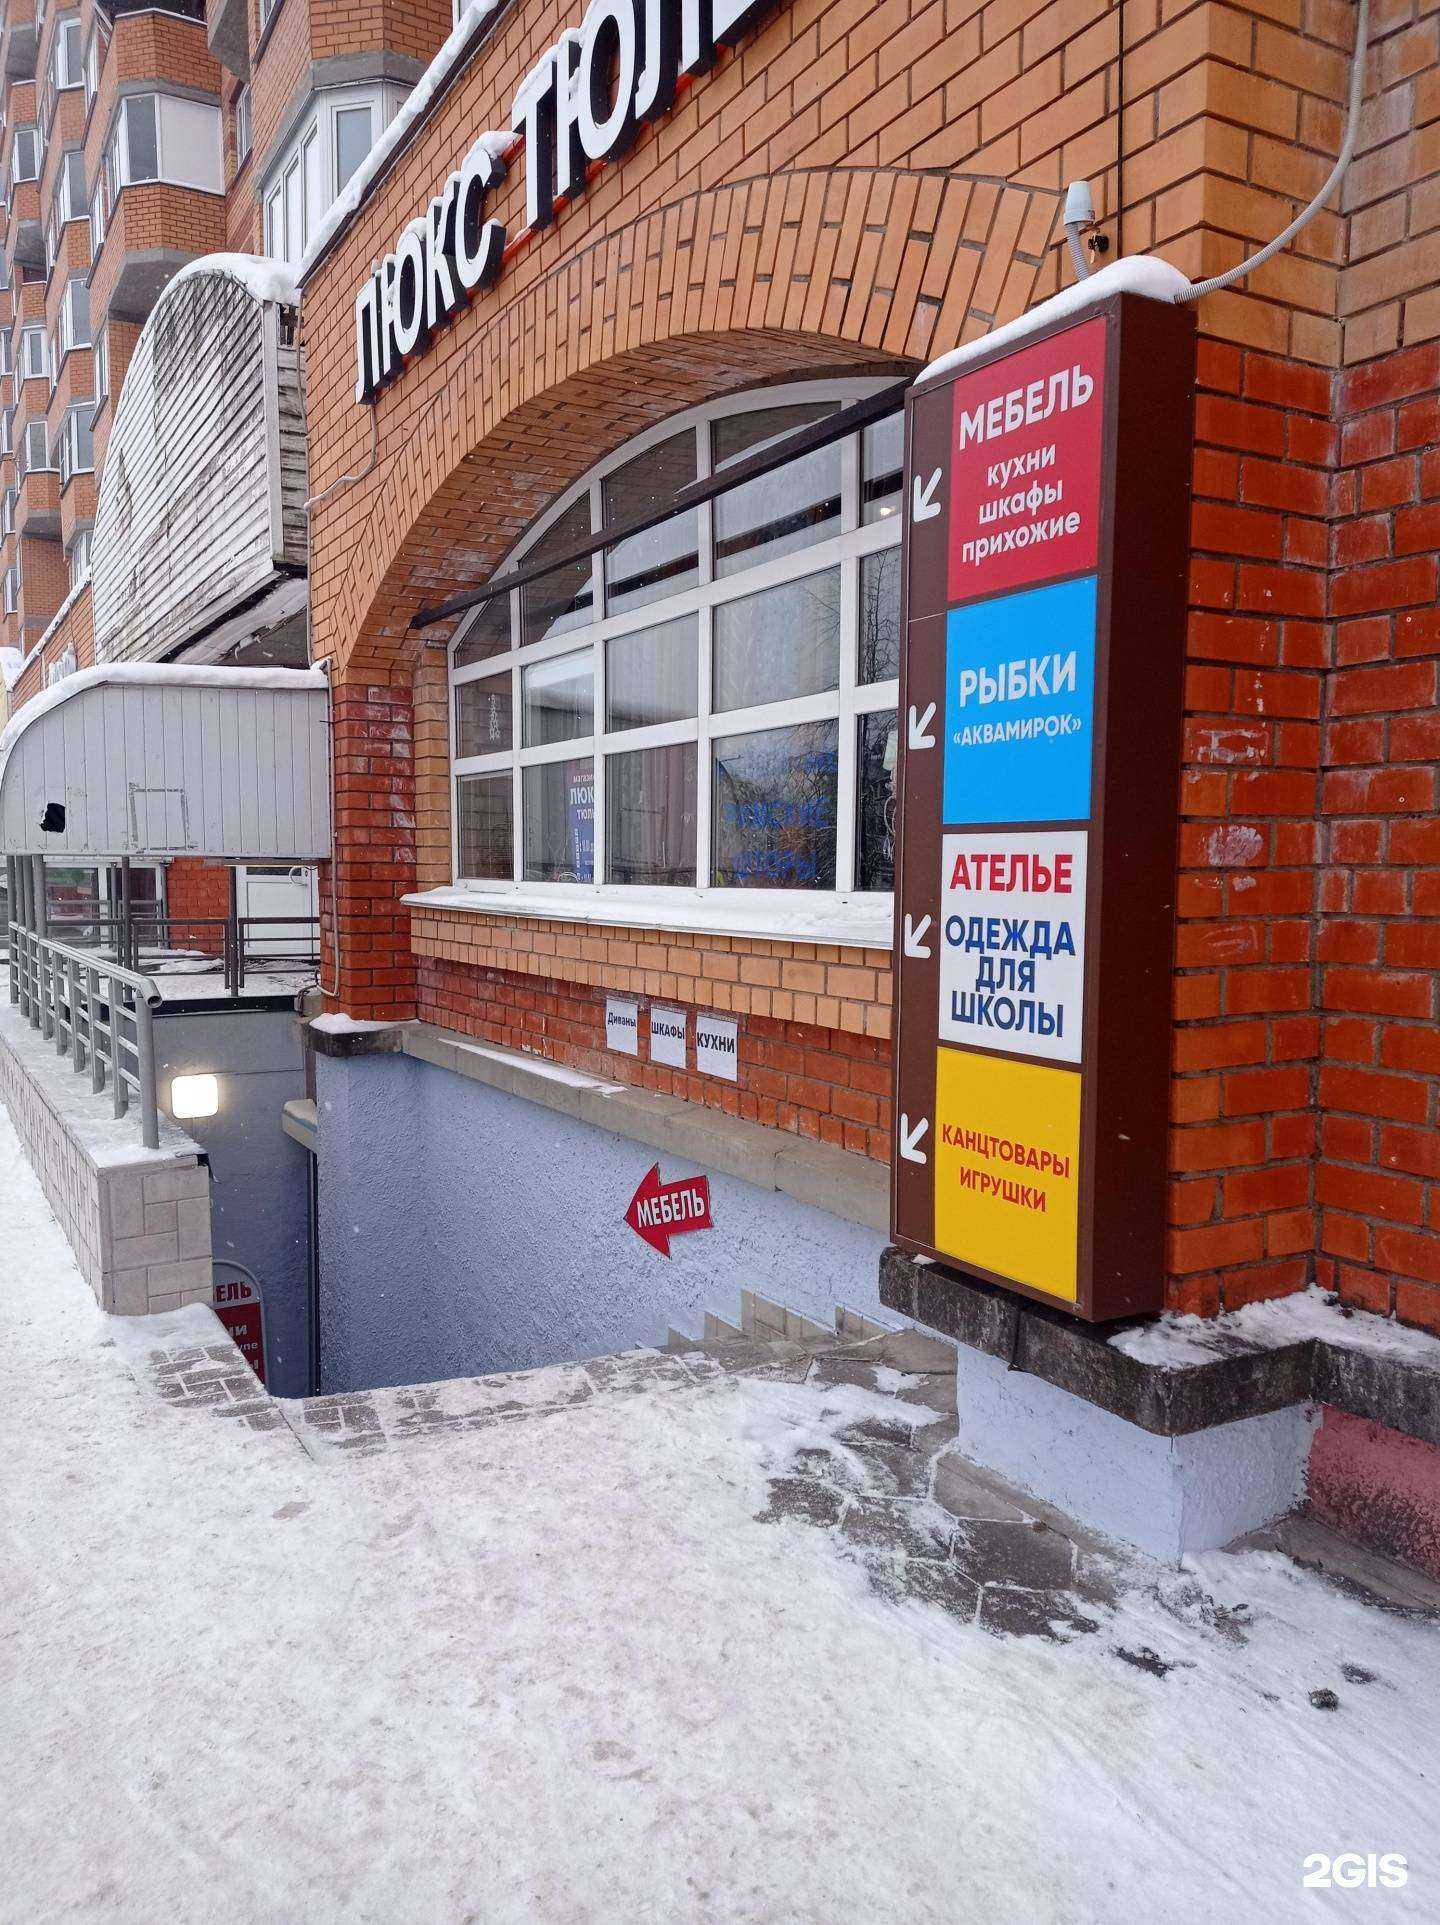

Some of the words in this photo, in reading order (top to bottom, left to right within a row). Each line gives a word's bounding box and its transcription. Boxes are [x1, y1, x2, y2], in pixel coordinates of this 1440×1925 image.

[355, 147, 504, 405] ЛЮКС
[959, 364, 1095, 451] МЕБЕЛЬ
[986, 443, 1057, 490] кухни
[978, 480, 1064, 526] шкафы
[962, 511, 1082, 567] прихожие
[959, 651, 1077, 708] РЫБКИ
[953, 713, 1083, 747] «АКВАМИРОК»
[949, 854, 1074, 894] АТЕЛЬЕ
[945, 915, 1077, 961] ОДЕЖДА
[975, 956, 1036, 994] ДЛЯ
[606, 1012, 637, 1028] Диваны
[651, 1021, 685, 1040] ШКАФЫ
[951, 990, 1064, 1038] ШКОЛЫ
[696, 1031, 736, 1054] КУХНИ
[942, 1123, 1071, 1178] КАНЦТОВАРЫ
[636, 1188, 706, 1228] МЕБЕЛЬ
[959, 1166, 1047, 1213] ИГРУШКИ
[213, 1282, 253, 1303] ЕЛЬ
